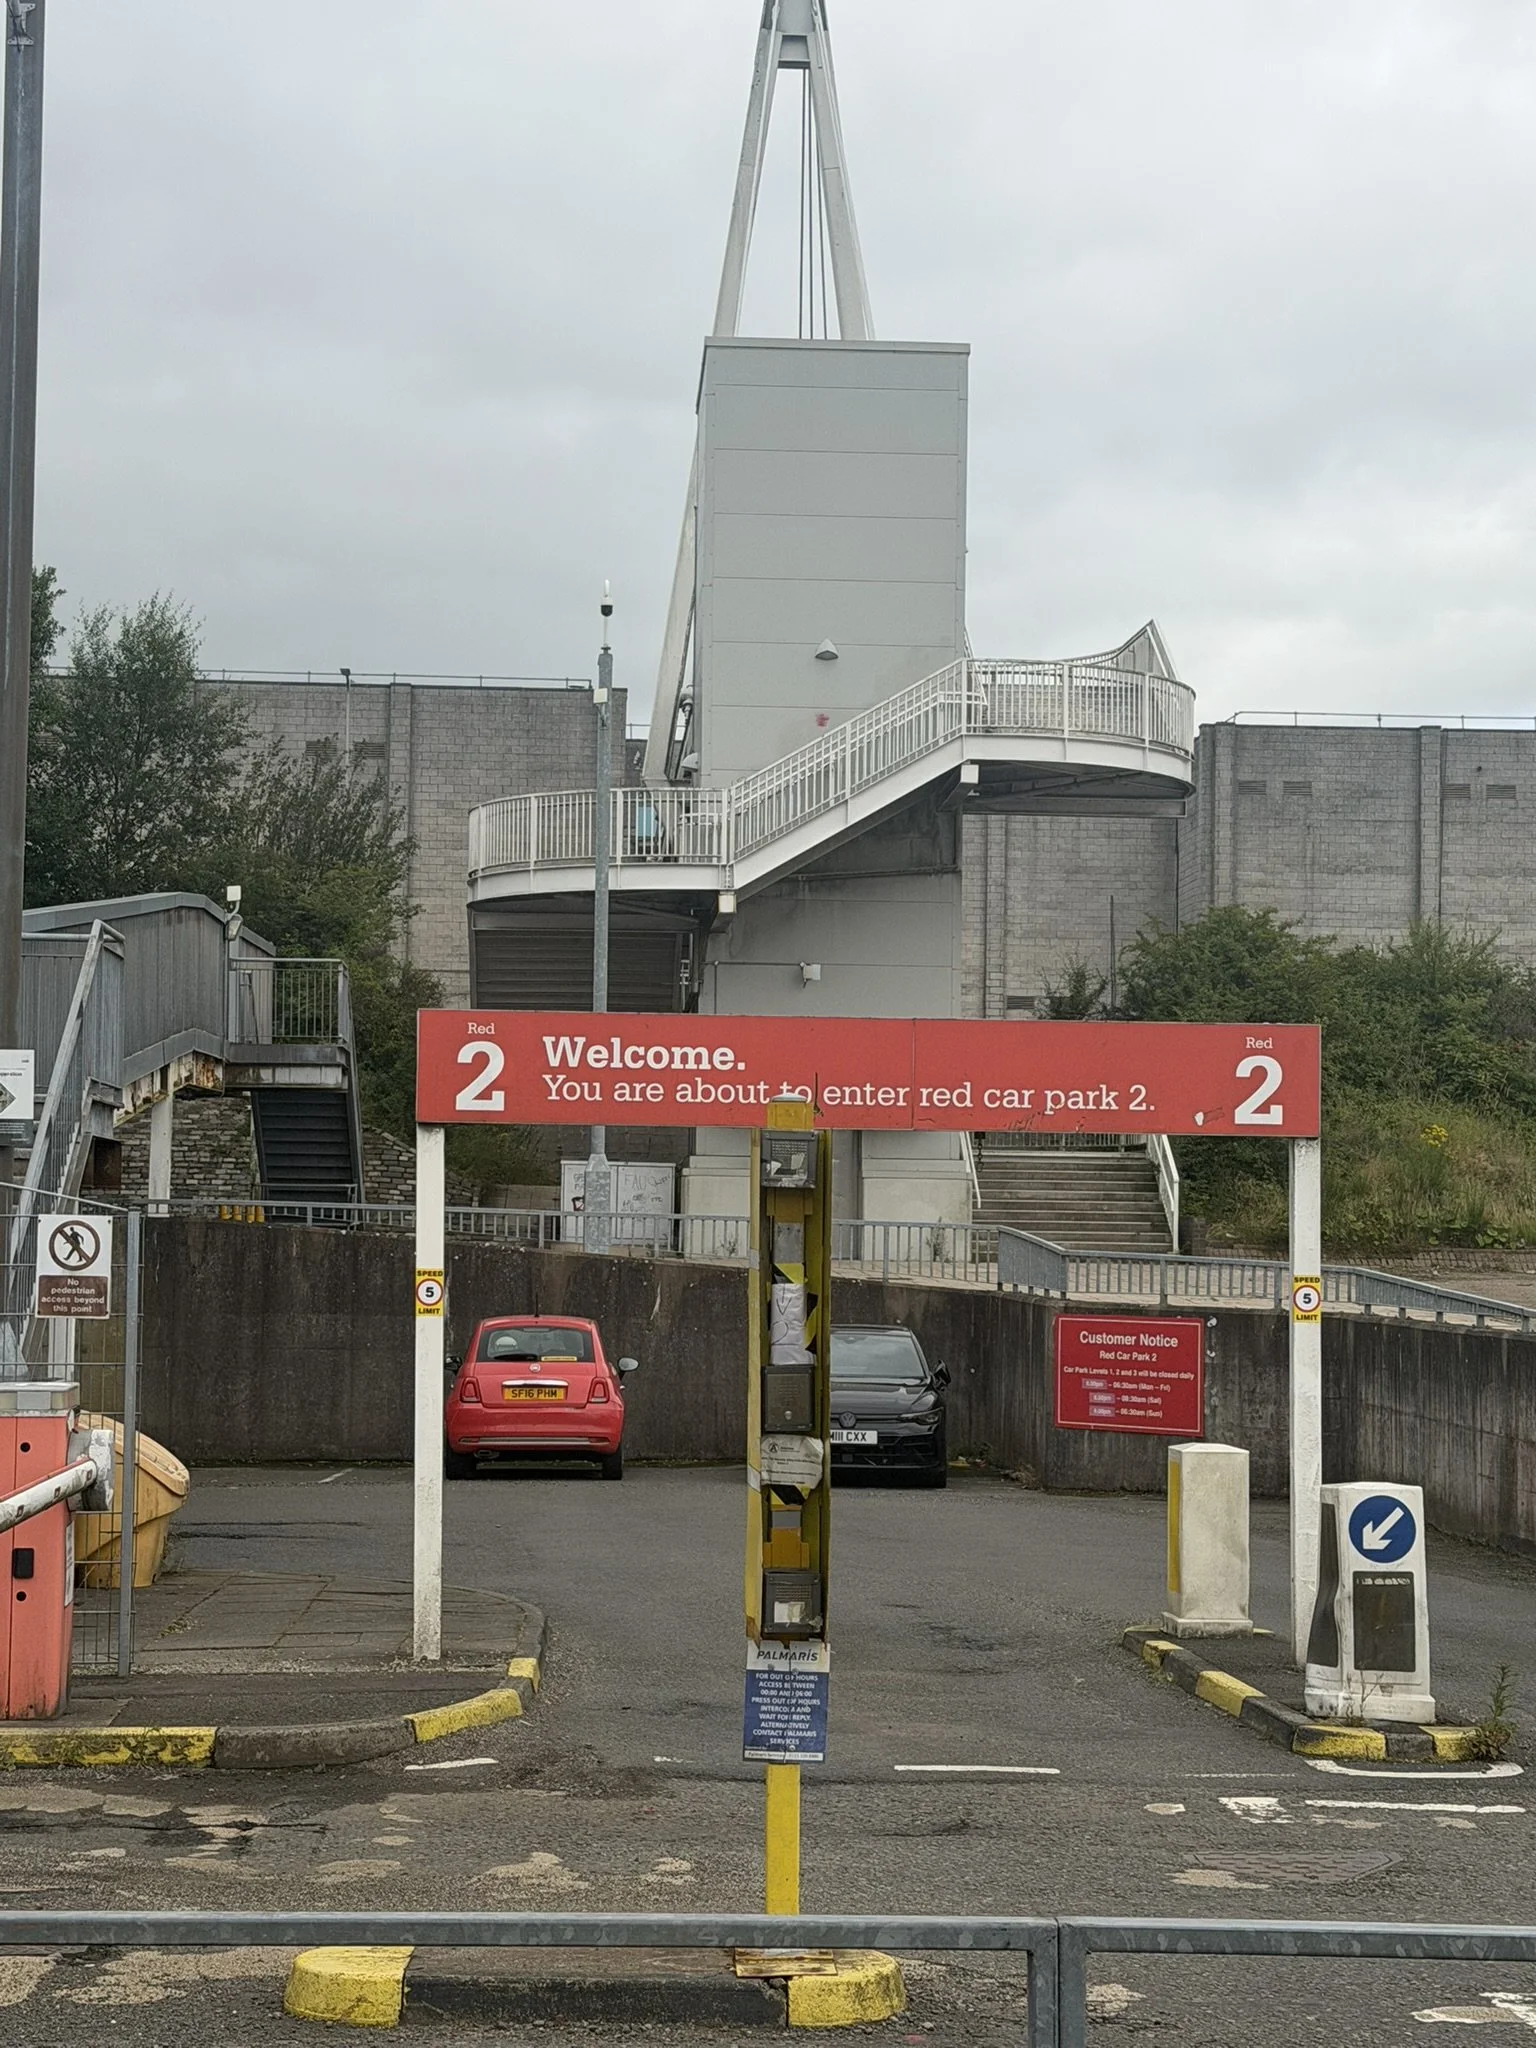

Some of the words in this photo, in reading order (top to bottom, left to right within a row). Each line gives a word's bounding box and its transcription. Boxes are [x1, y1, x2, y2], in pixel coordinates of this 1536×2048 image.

[468, 1022, 495, 1036] Red
[1245, 1036, 1273, 1050] Red
[542, 1035, 747, 1072] Welcome.
[455, 1040, 505, 1112] 2
[543, 1074, 603, 1102] You
[613, 1080, 665, 1103] are
[676, 1078, 770, 1104] about
[779, 1081, 812, 1104] to
[823, 1082, 910, 1108] enter
[920, 1081, 973, 1108] red
[983, 1088, 1035, 1109] car
[1044, 1084, 1119, 1116] park
[1128, 1088, 1156, 1111] 2.
[1234, 1055, 1284, 1125] 2
[67, 1278, 79, 1286] No
[51, 1286, 95, 1295] pedestrian
[425, 1286, 435, 1298] 5
[74, 1295, 105, 1305] beyond
[1302, 1293, 1312, 1304] 5
[71, 1305, 92, 1313] point
[1079, 1331, 1136, 1346] Customer
[1140, 1333, 1178, 1348] Notice
[1099, 1350, 1115, 1360] Red
[1117, 1351, 1130, 1360] Car
[1132, 1352, 1150, 1361] Park
[1151, 1353, 1157, 1362] 2
[1089, 1367, 1108, 1375] Levels
[1180, 1372, 1194, 1380] daily
[511, 1389, 534, 1398] SF16
[537, 1389, 557, 1398] PHM
[846, 1432, 867, 1441] CXX
